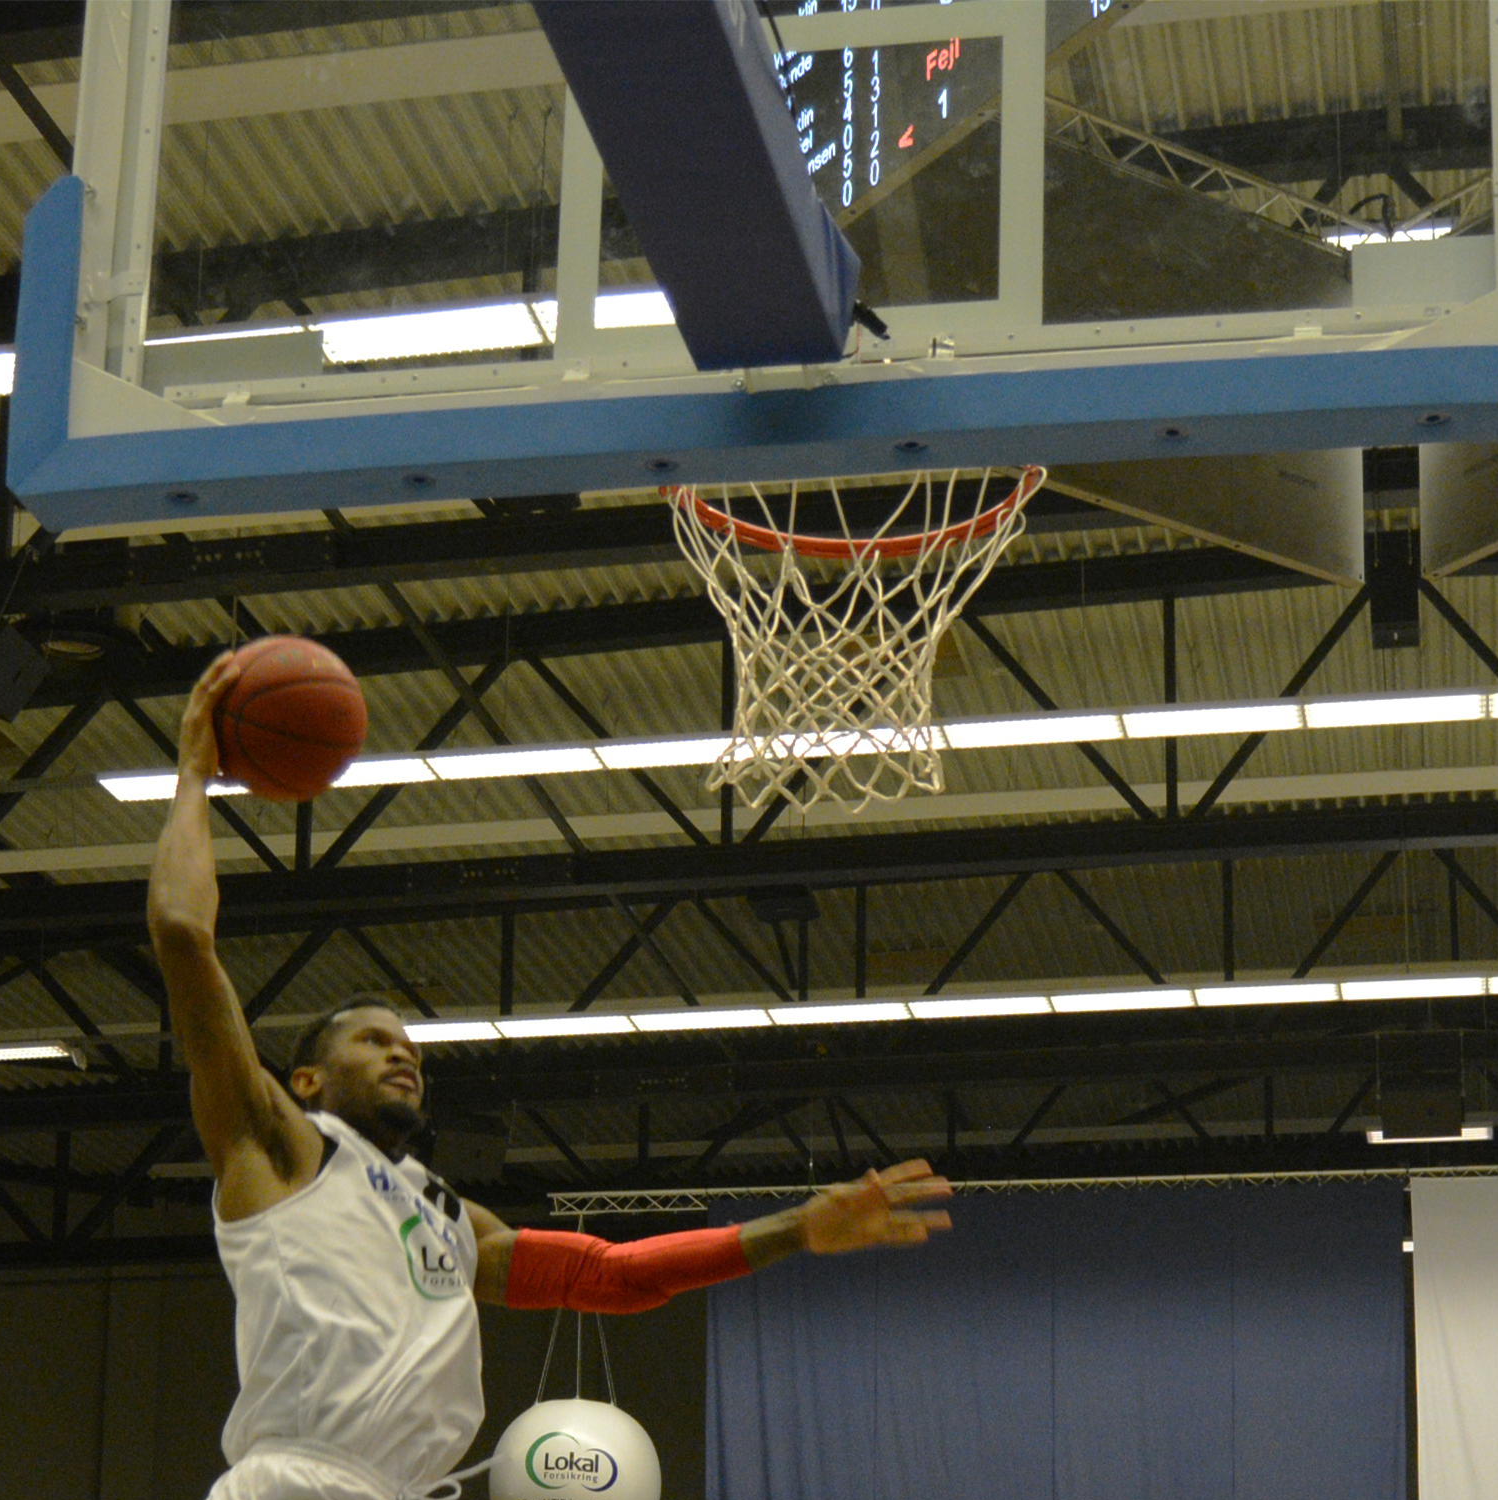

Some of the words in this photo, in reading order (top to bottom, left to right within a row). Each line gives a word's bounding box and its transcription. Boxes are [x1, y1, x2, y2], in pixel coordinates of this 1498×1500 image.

[926, 37, 960, 81] Fejl
[870, 75, 880, 103] 3
[937, 88, 948, 119] 1
[544, 1451, 599, 1473] Lokal
[543, 1472, 598, 1484] Forsikring
